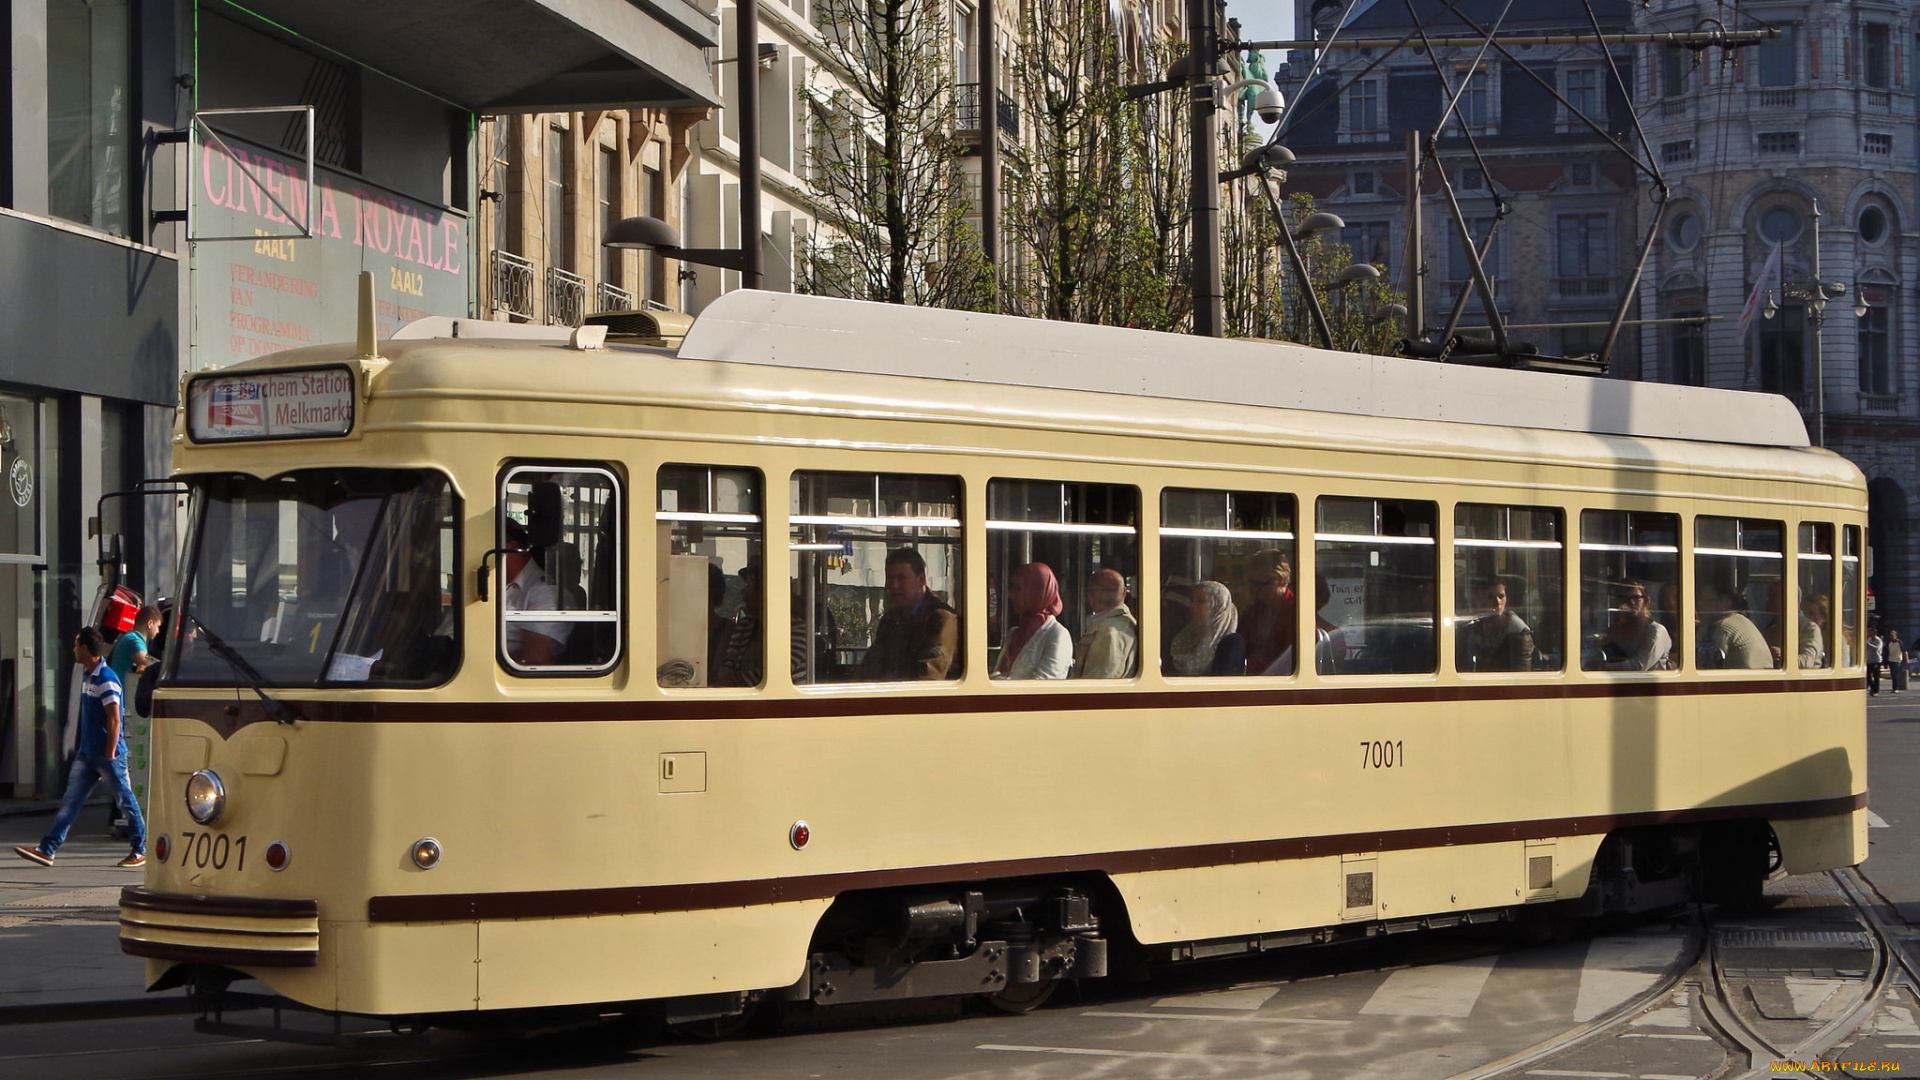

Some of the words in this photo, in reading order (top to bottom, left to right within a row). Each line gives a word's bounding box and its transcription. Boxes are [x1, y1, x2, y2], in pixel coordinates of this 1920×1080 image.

[203, 139, 343, 239] CINEMA
[351, 187, 461, 275] ROYALE
[229, 262, 318, 299] VERANDERING
[229, 286, 254, 307] VAN
[229, 310, 312, 342] PROGRAMMA
[377, 321, 391, 337] AN
[230, 334, 246, 353] OP
[302, 369, 352, 395] Station
[276, 399, 353, 425] Melkmarkt
[309, 622, 322, 654] 1
[1360, 740, 1403, 769] 7001
[181, 832, 247, 871] 7001
